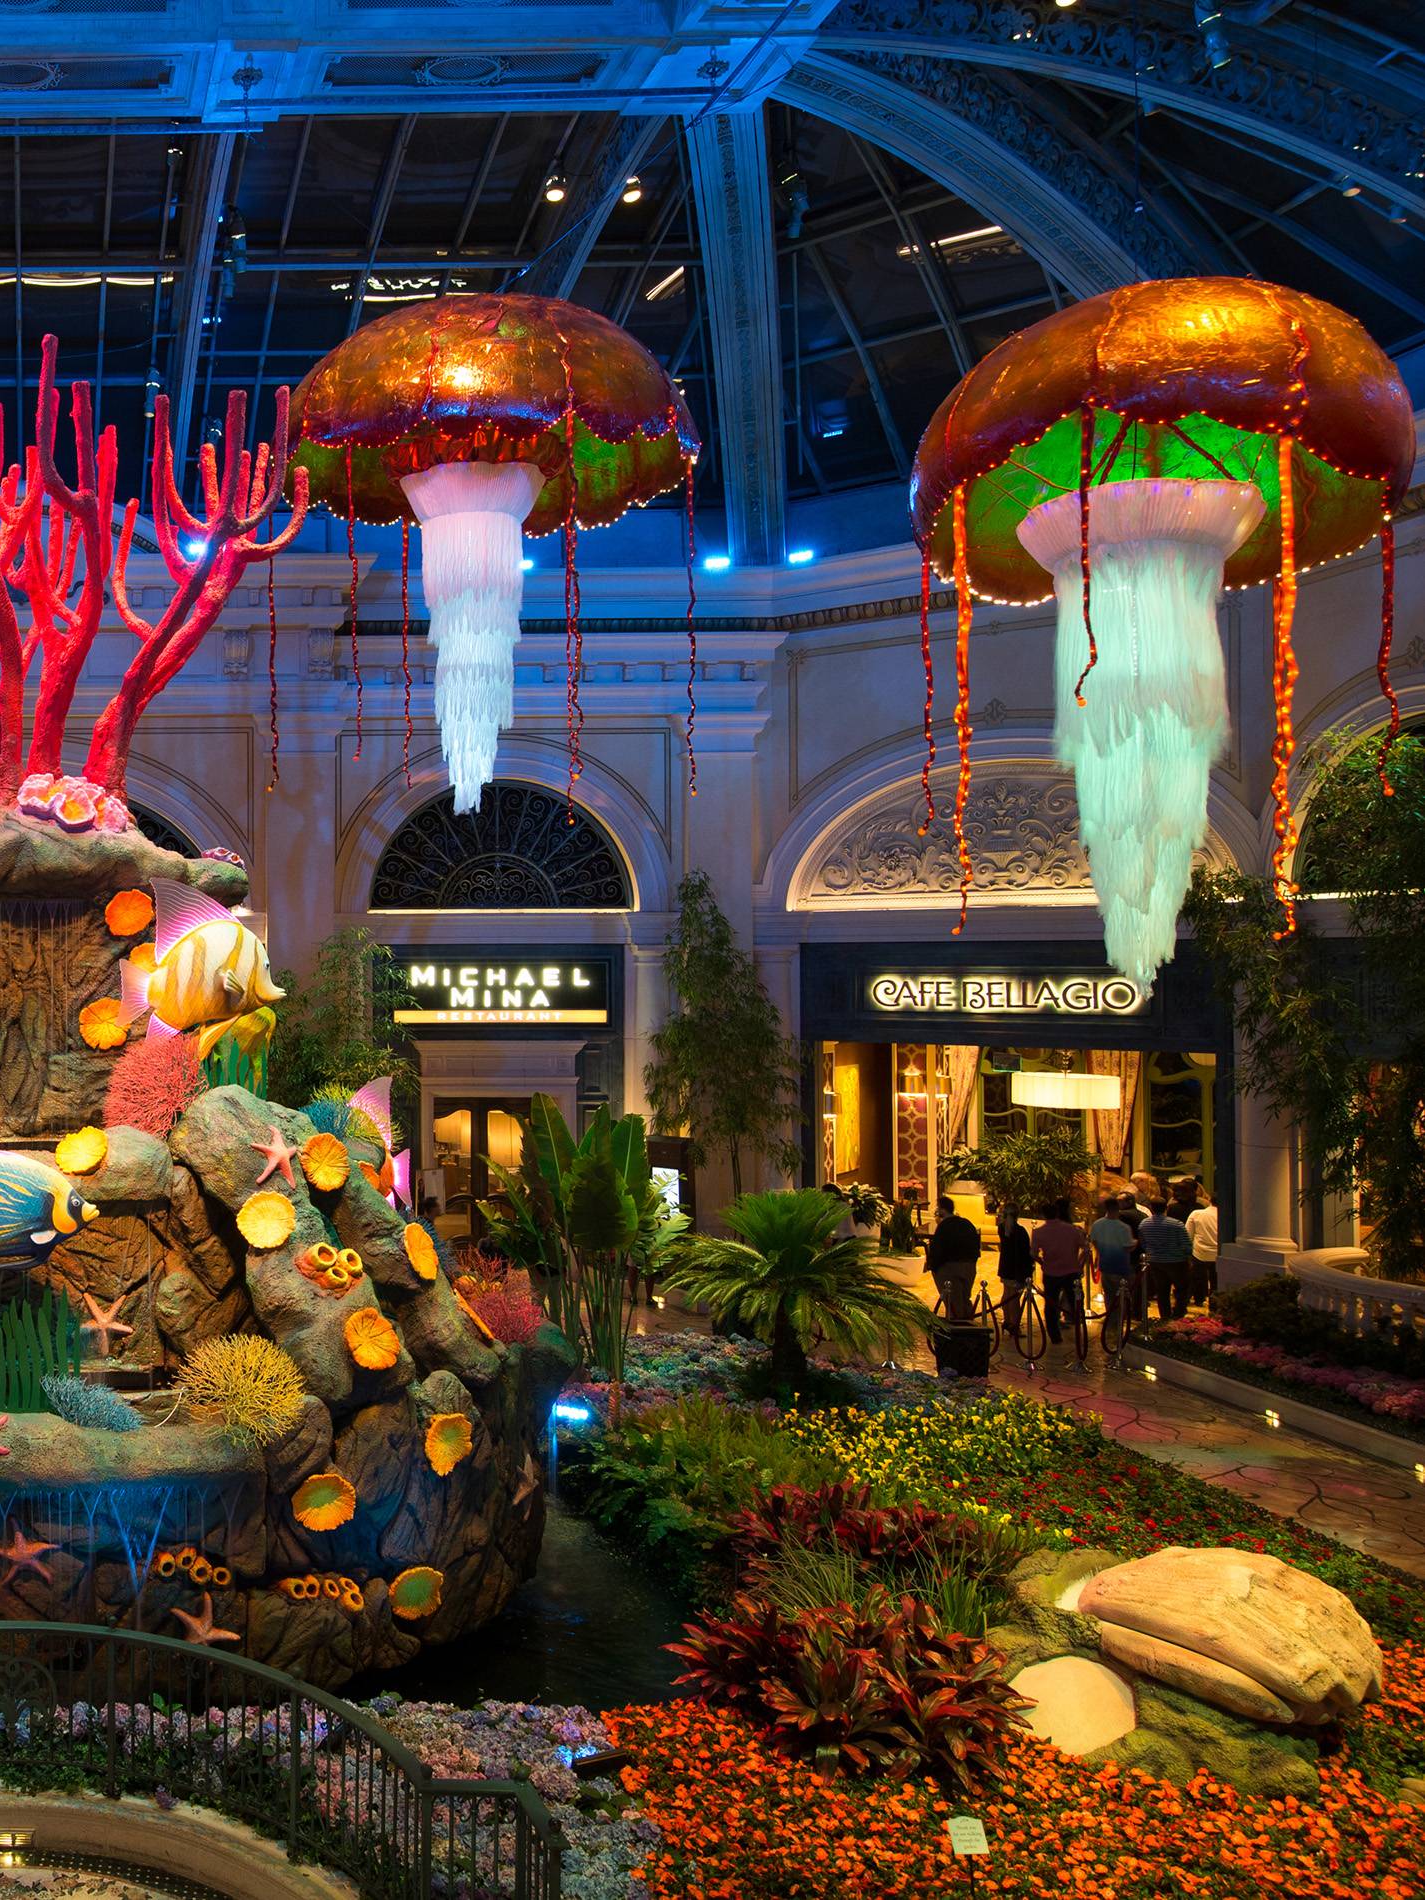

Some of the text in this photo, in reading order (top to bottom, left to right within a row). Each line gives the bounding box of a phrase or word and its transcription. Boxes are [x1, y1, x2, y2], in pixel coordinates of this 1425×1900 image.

[410, 965, 591, 987] MICHAEL
[449, 987, 551, 1008] MINA
[872, 979, 1137, 1010] CAFE BELLAGIO
[436, 1011, 563, 1021] RESTAURANT
